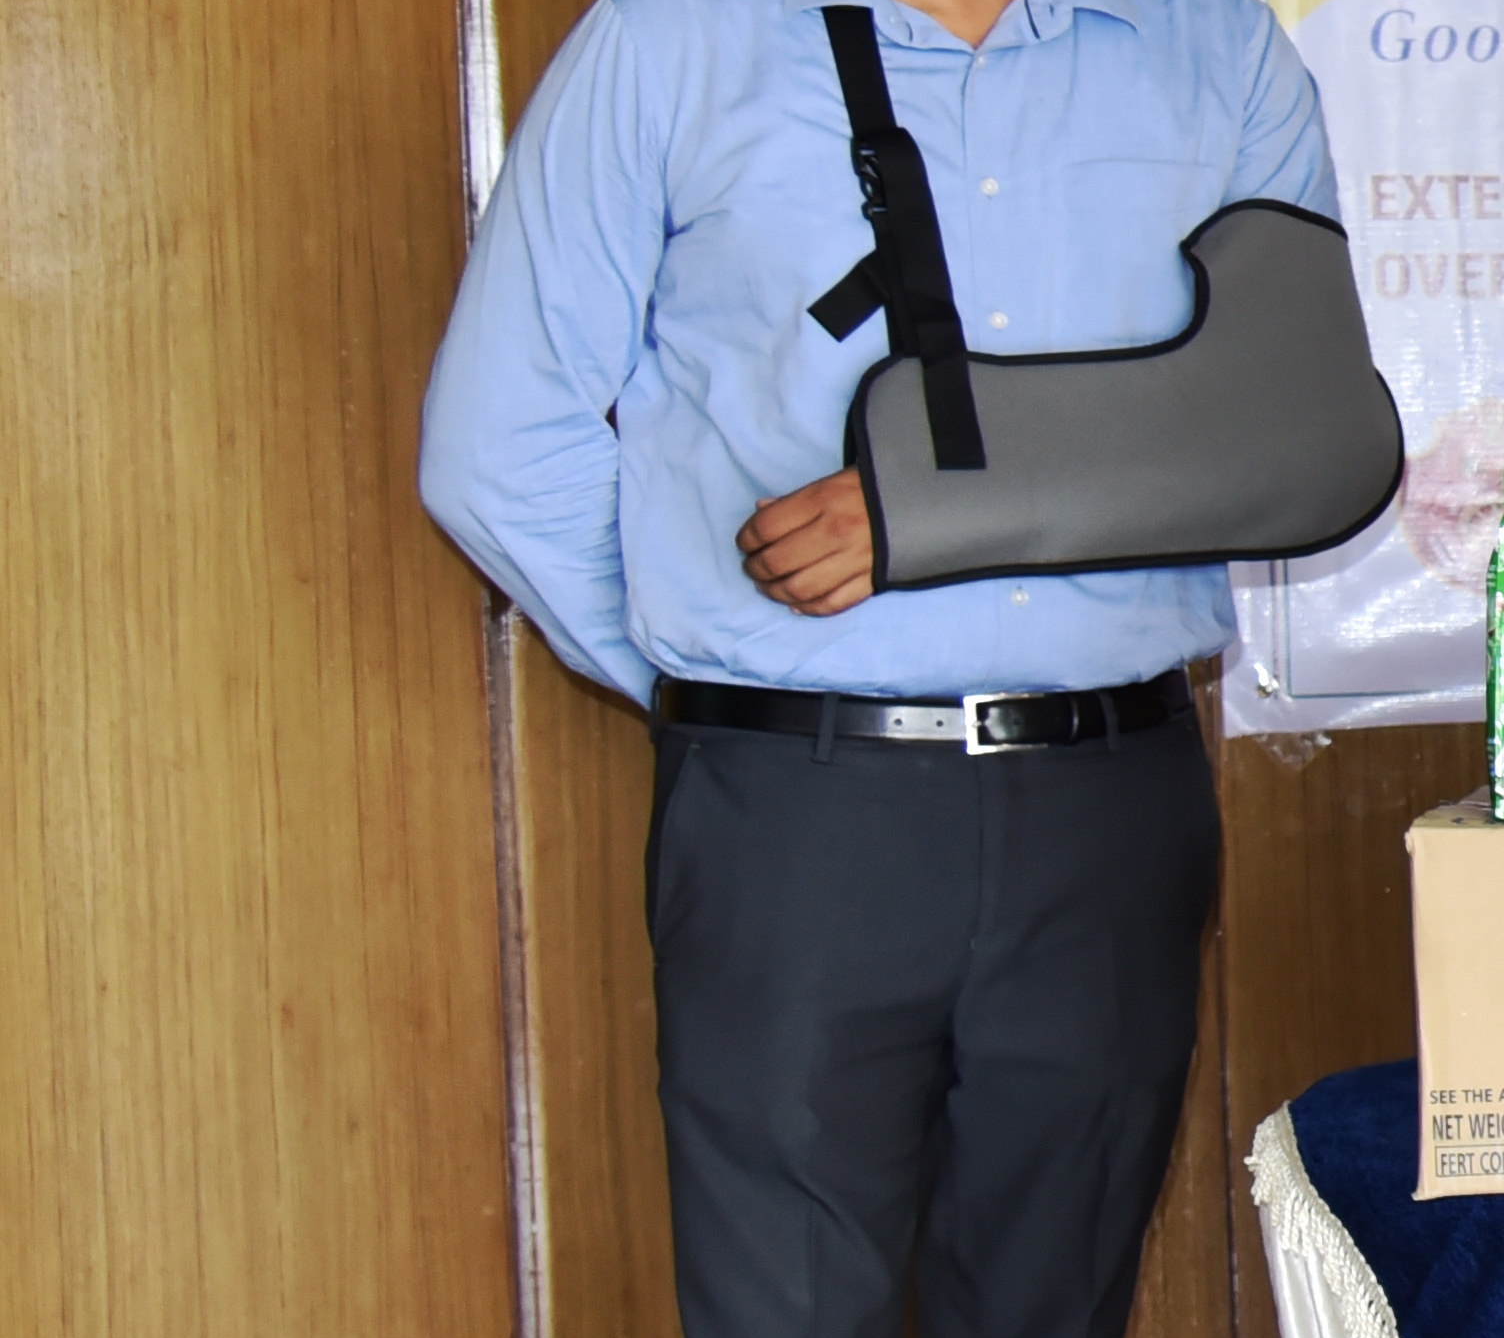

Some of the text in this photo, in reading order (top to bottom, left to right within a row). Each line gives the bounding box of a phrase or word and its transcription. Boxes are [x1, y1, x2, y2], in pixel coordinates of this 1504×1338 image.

[1429, 1089, 1457, 1105] SEE
[1461, 1088, 1493, 1103] THE
[1432, 1114, 1463, 1140] NET
[1440, 1152, 1475, 1176] FERT
